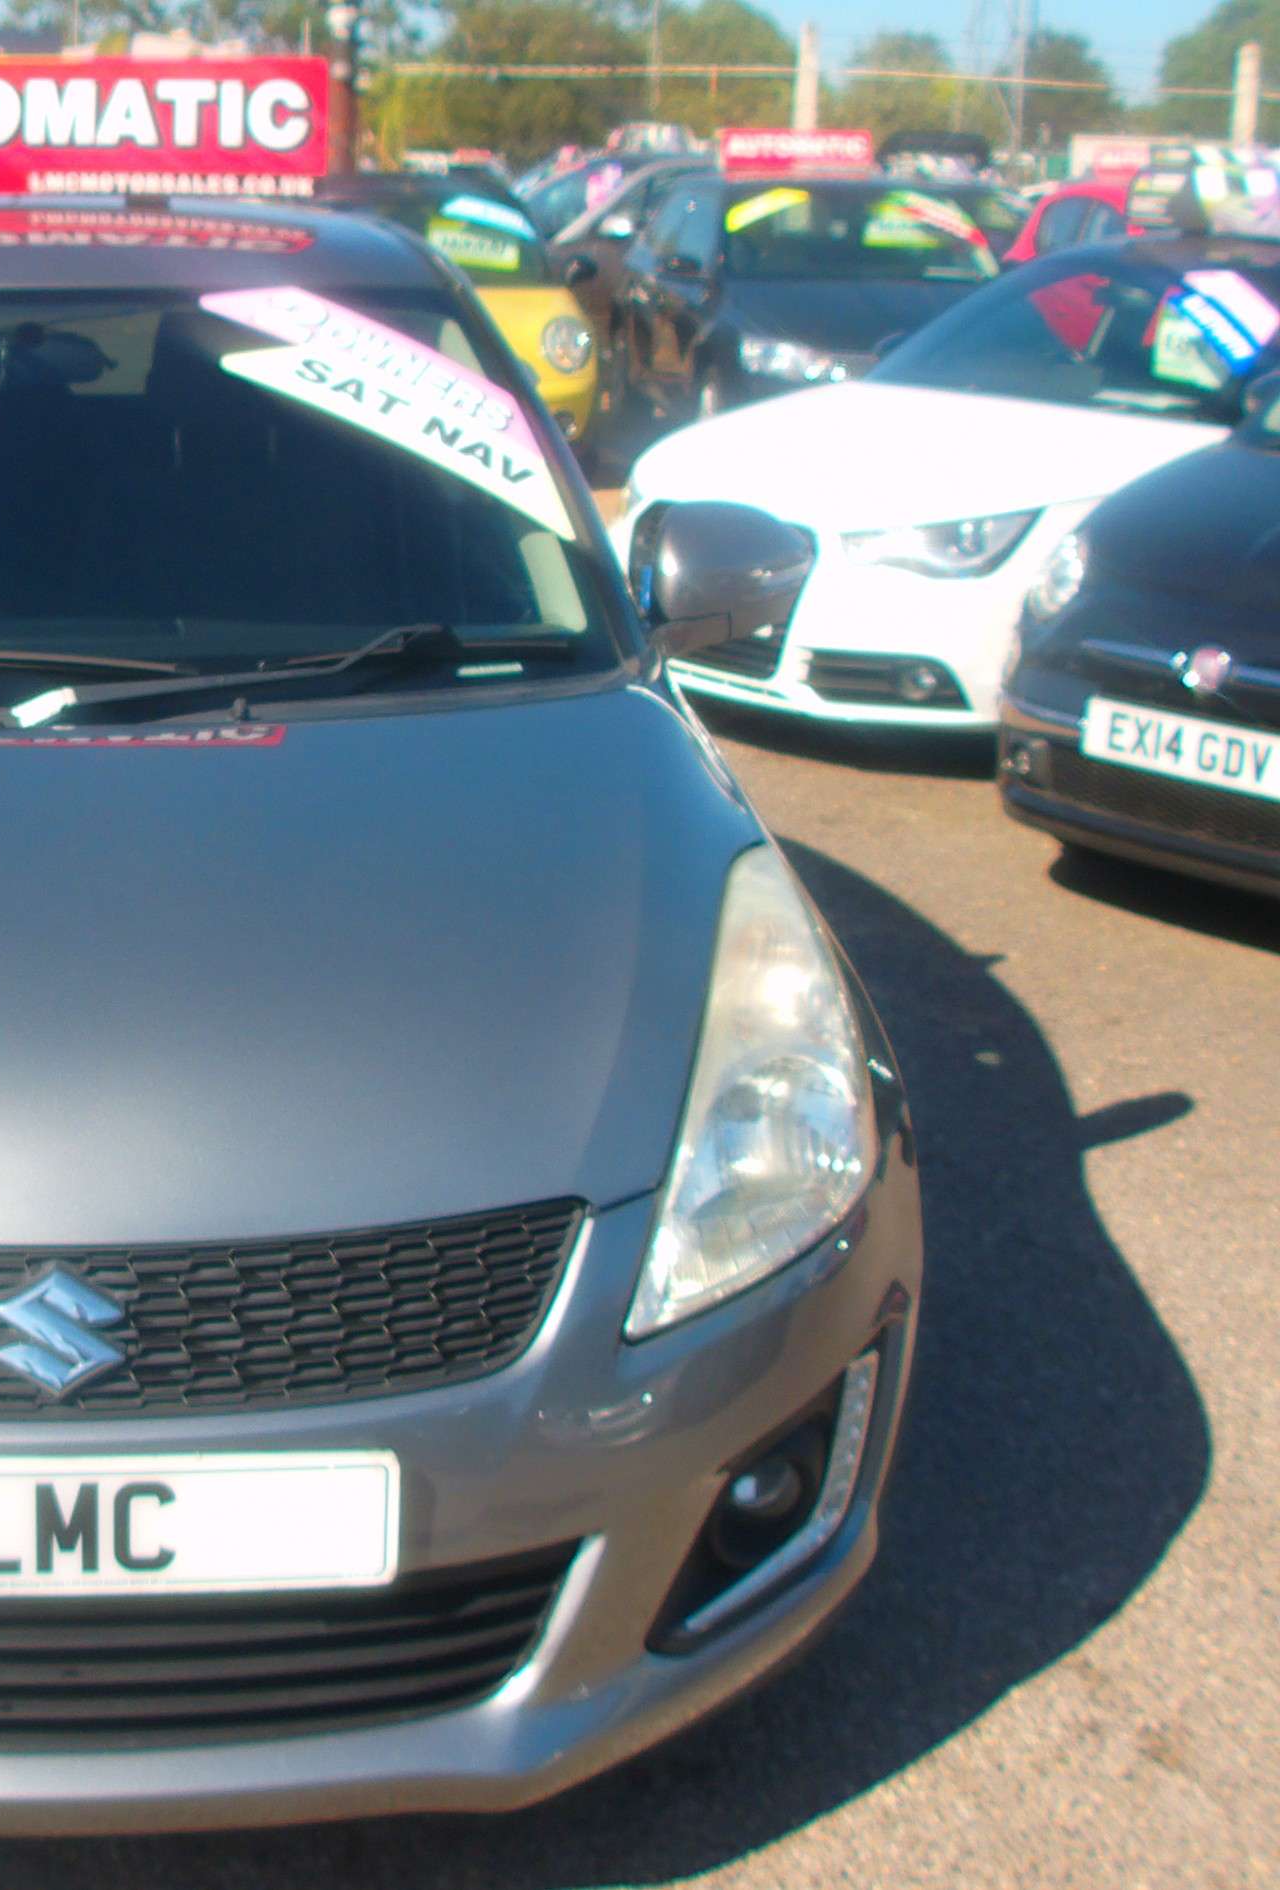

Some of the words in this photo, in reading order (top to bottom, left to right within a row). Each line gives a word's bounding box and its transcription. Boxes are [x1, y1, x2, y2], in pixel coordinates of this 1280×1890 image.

[294, 357, 413, 416] SAT
[421, 415, 536, 484] NAV
[1108, 711, 1184, 764] EX14
[1197, 732, 1272, 782] GDV
